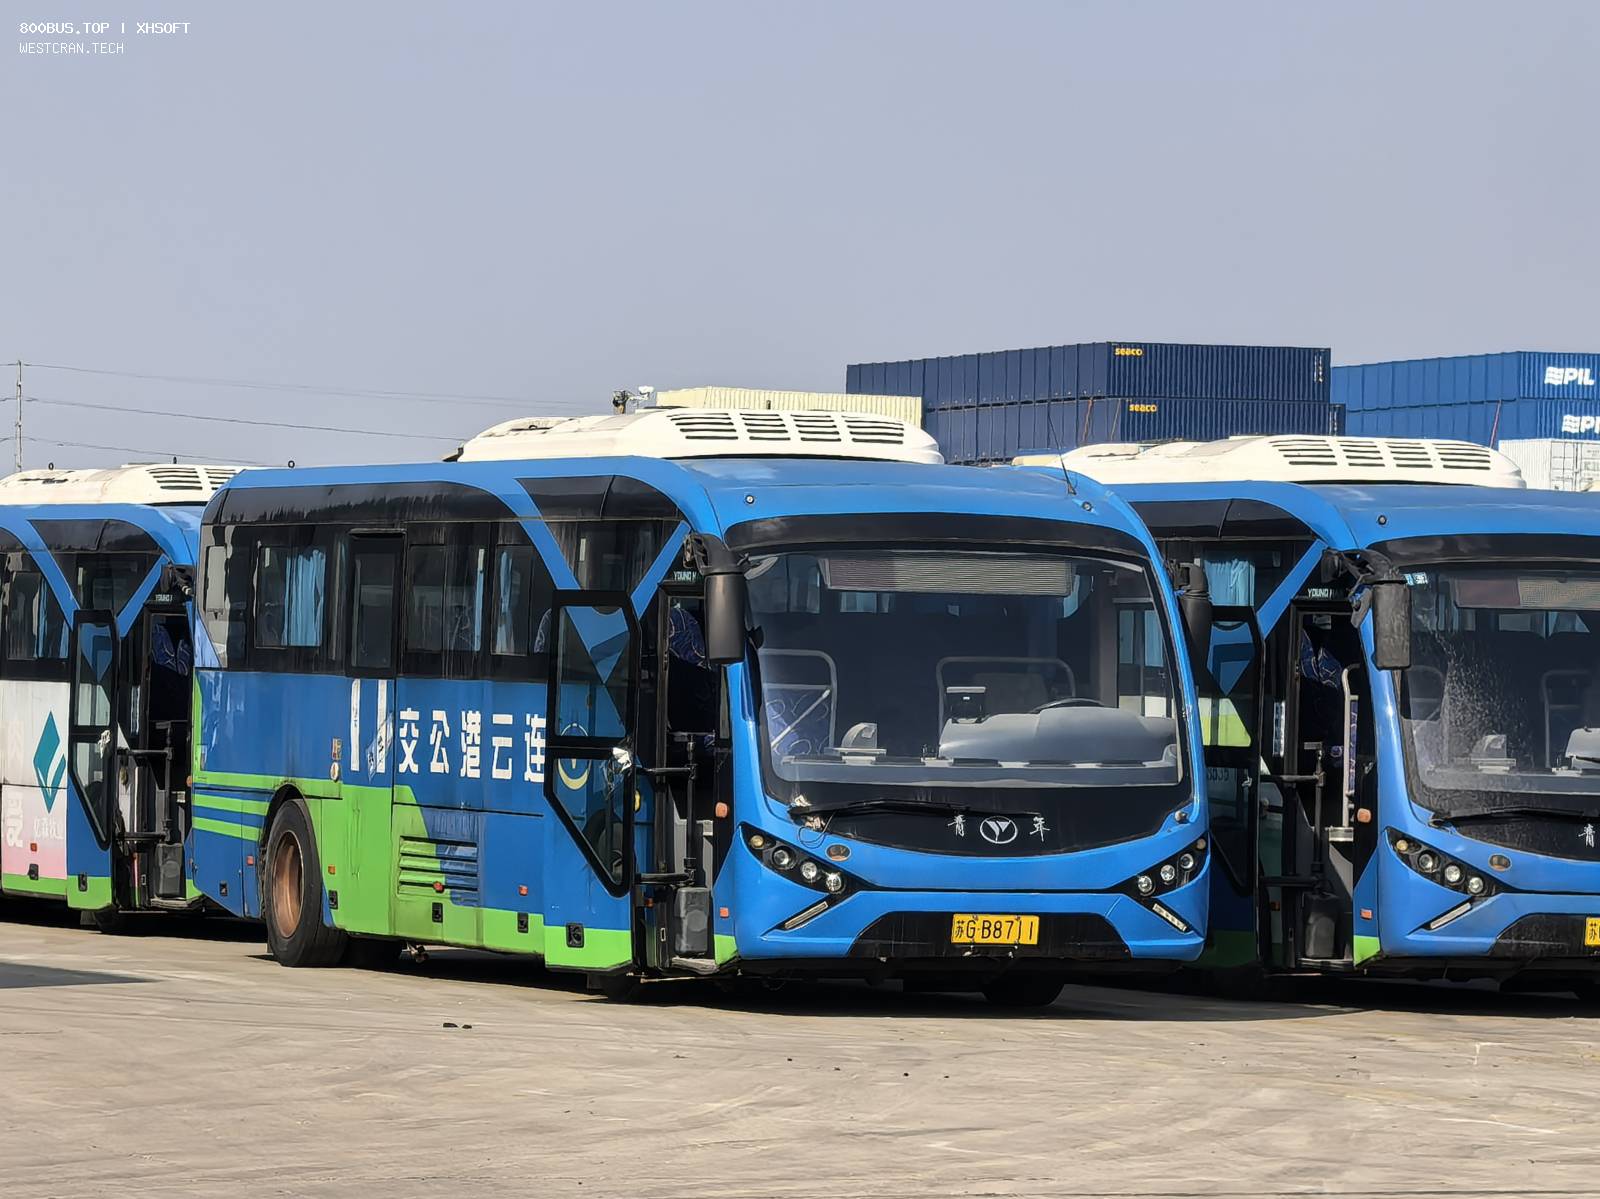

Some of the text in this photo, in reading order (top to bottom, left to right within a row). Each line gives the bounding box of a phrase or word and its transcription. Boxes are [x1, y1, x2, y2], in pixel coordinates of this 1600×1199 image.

[1114, 347, 1143, 356] seaco
[1563, 367, 1595, 386] PIL
[1129, 404, 1157, 413] seaco
[1580, 416, 1600, 434] PI
